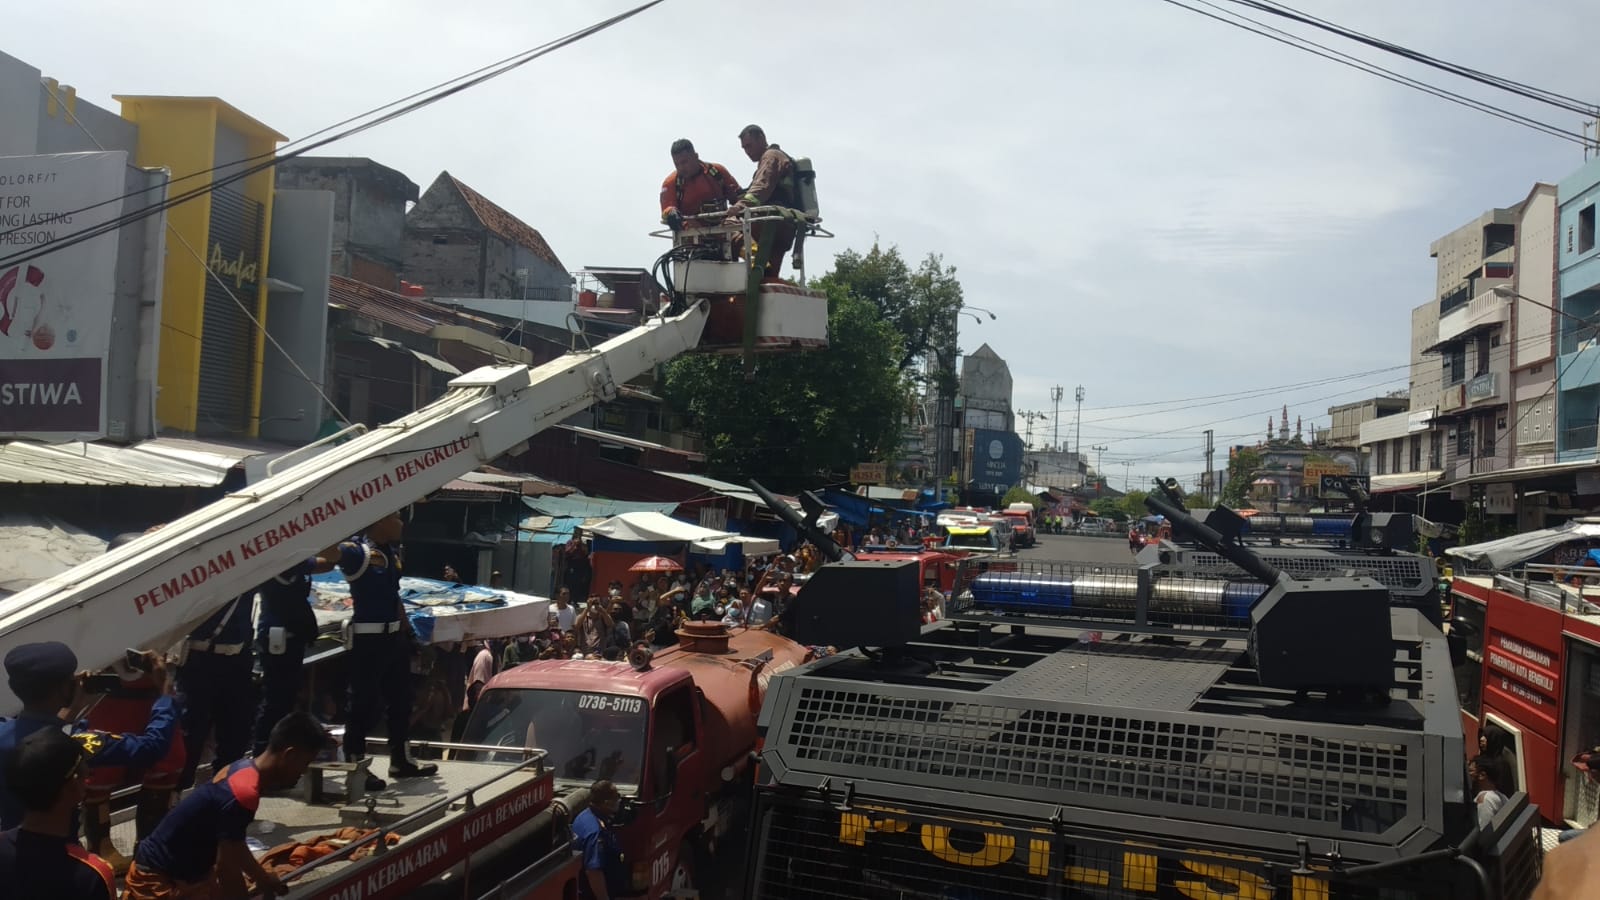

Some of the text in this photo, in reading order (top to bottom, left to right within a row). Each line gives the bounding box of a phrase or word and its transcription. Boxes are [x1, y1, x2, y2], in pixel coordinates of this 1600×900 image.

[7, 195, 31, 209] FOR
[23, 211, 73, 227] LASTING
[1, 382, 83, 406] STIWA
[133, 434, 471, 615] PEMADAM KEBAKARAN KOTA BENGKULU
[578, 694, 642, 713] 0736-51113
[367, 835, 448, 896] KEBAKARAN
[463, 812, 493, 843] KOTA
[495, 783, 546, 825] BENGKULU
